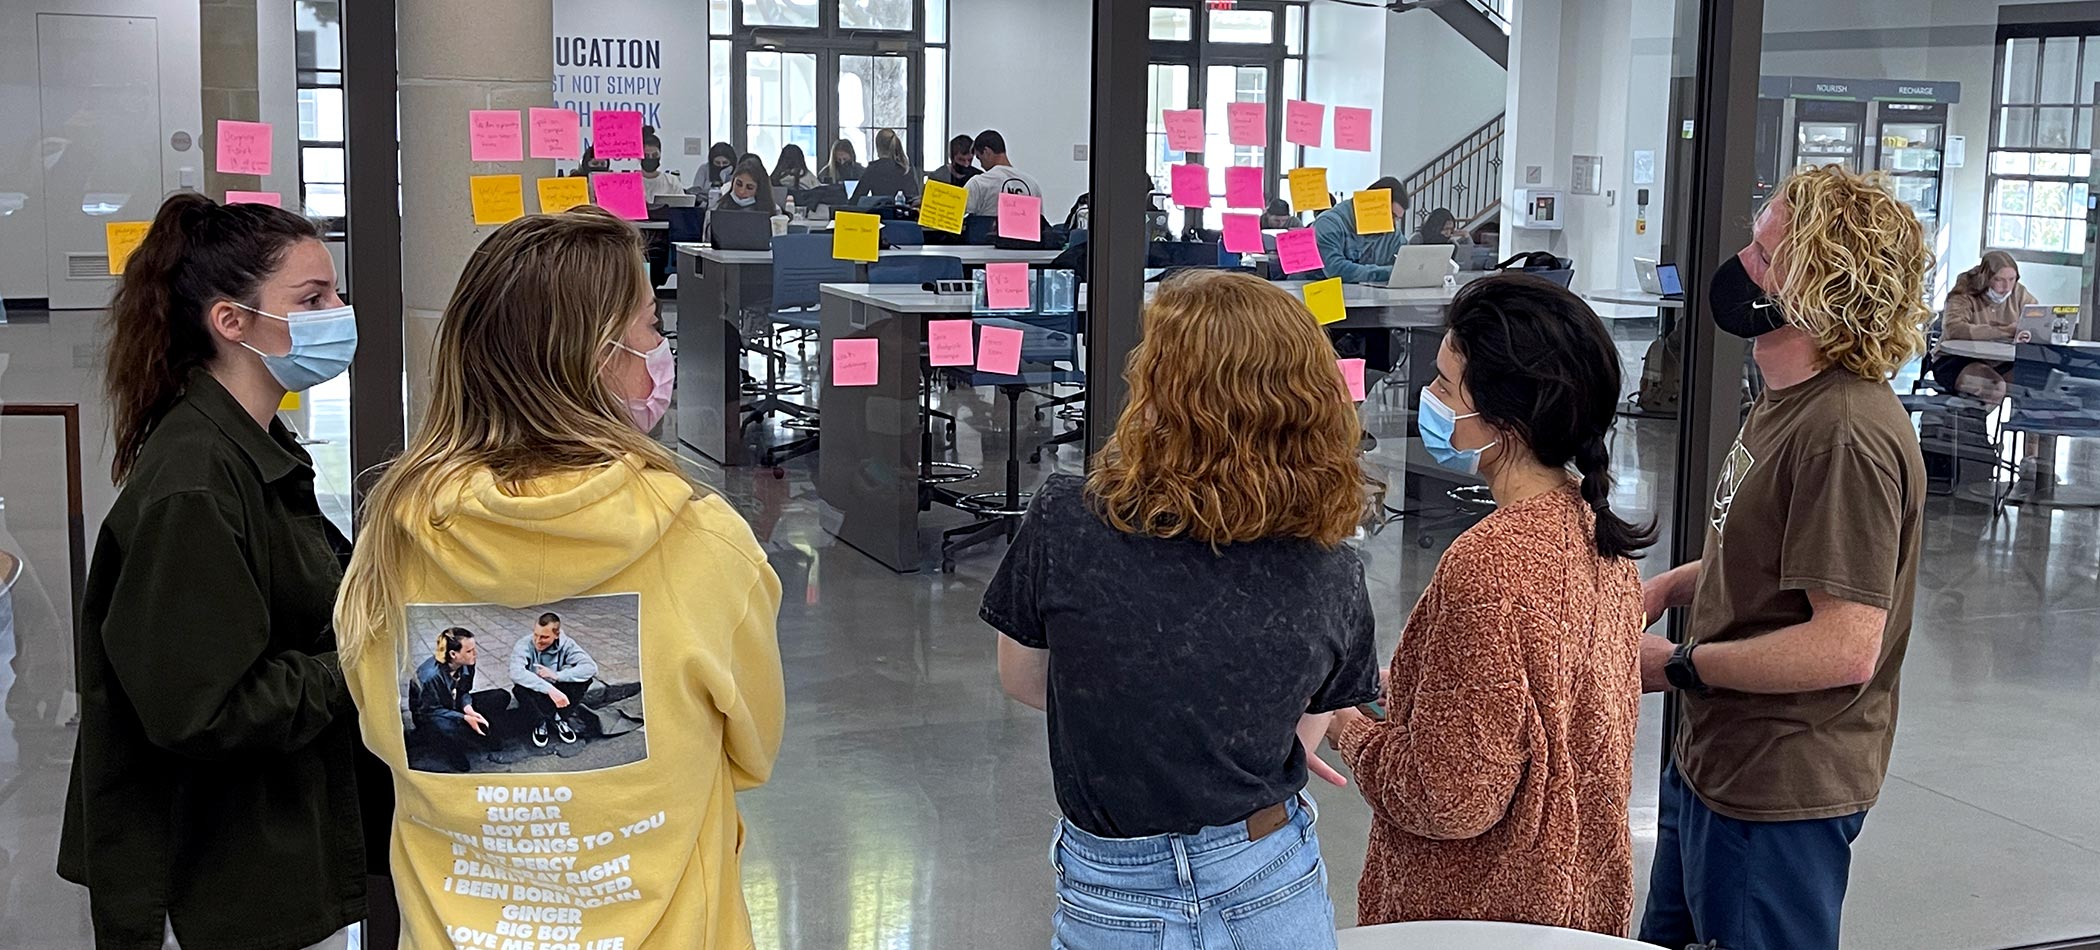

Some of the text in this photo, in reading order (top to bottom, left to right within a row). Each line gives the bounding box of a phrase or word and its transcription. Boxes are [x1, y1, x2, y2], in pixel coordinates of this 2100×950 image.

[572, 75, 600, 94] NOT
[607, 76, 661, 95] SIMPLY
[1816, 84, 1847, 93] NOURISH
[1898, 87, 1934, 95] RECHARGE
[477, 785, 573, 804] NO HALO
[487, 806, 562, 822] SUGAR
[482, 822, 571, 838] BOY BYE
[482, 836, 580, 855] BELONGS
[582, 831, 615, 851] TO
[619, 810, 666, 839] YOU
[511, 856, 577, 874] PERCY
[565, 854, 631, 884] RIGHT
[444, 876, 642, 909] I BEEN BORN AGAIN
[502, 904, 582, 924] GINGER
[447, 924, 499, 949] LOVE
[500, 938, 536, 950] ME
[586, 936, 626, 950] LIFE
[496, 920, 583, 942] BIG BOY
